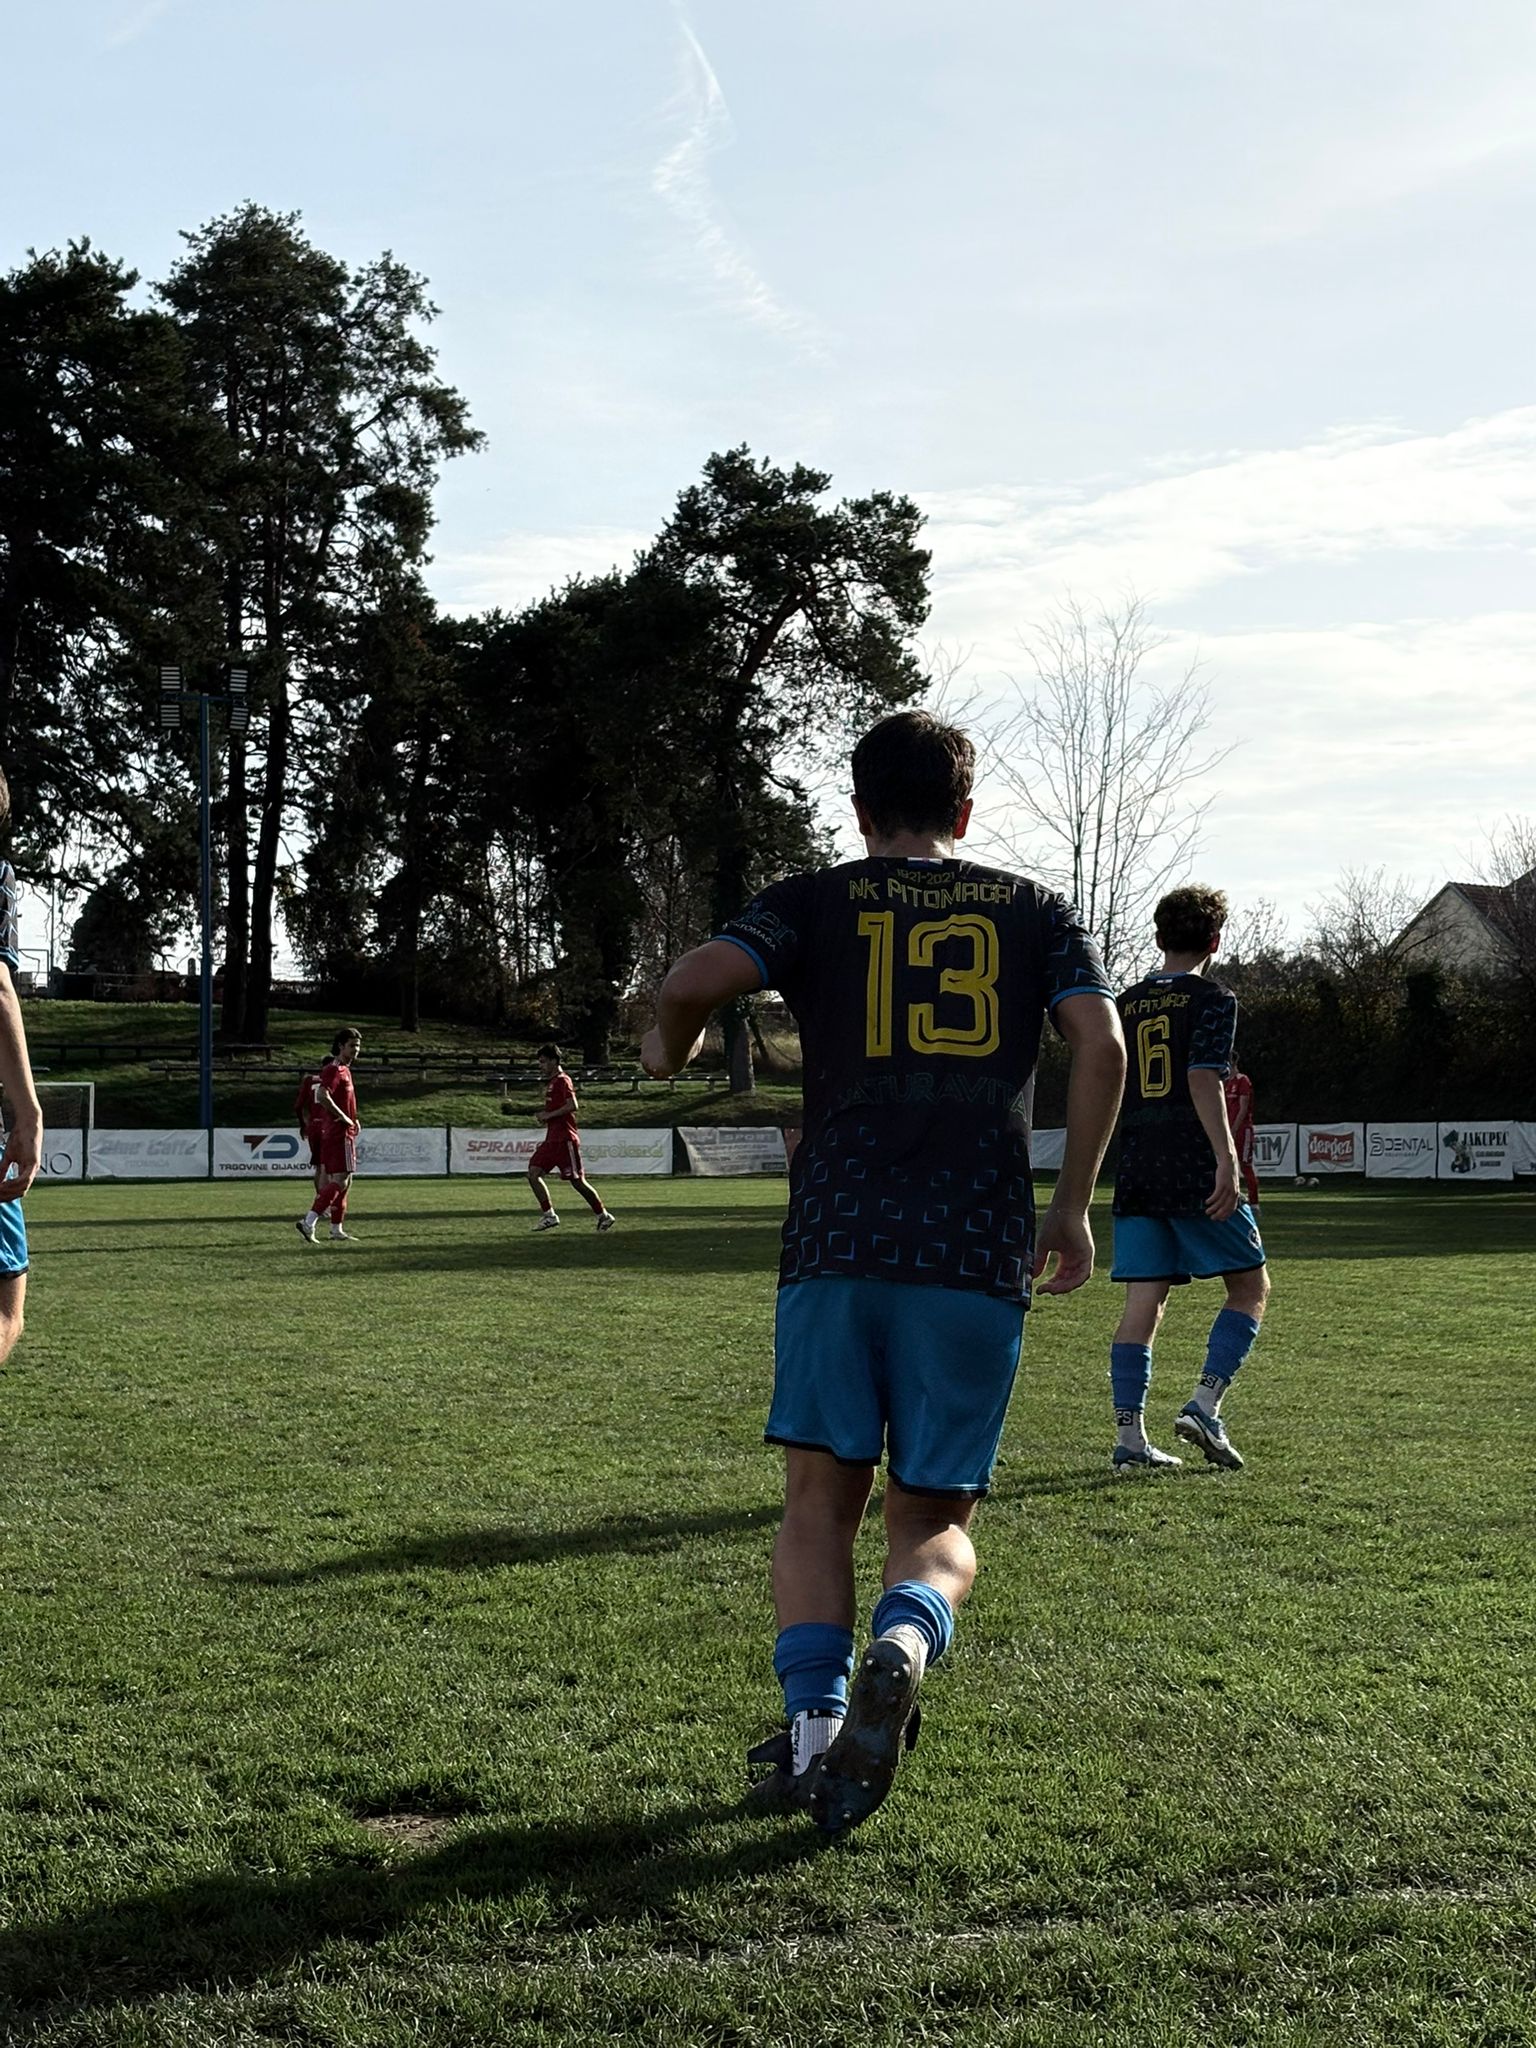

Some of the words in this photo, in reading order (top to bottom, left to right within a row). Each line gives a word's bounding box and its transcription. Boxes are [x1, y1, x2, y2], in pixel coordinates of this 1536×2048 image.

[848, 877, 881, 901] NK
[857, 910, 1000, 1058] 13
[1137, 1014, 1172, 1099] 6
[1385, 1137, 1434, 1156] DENTAL
[1461, 1131, 1510, 1147] JAKUPEC
[219, 1163, 268, 1171] TRGOVINE
